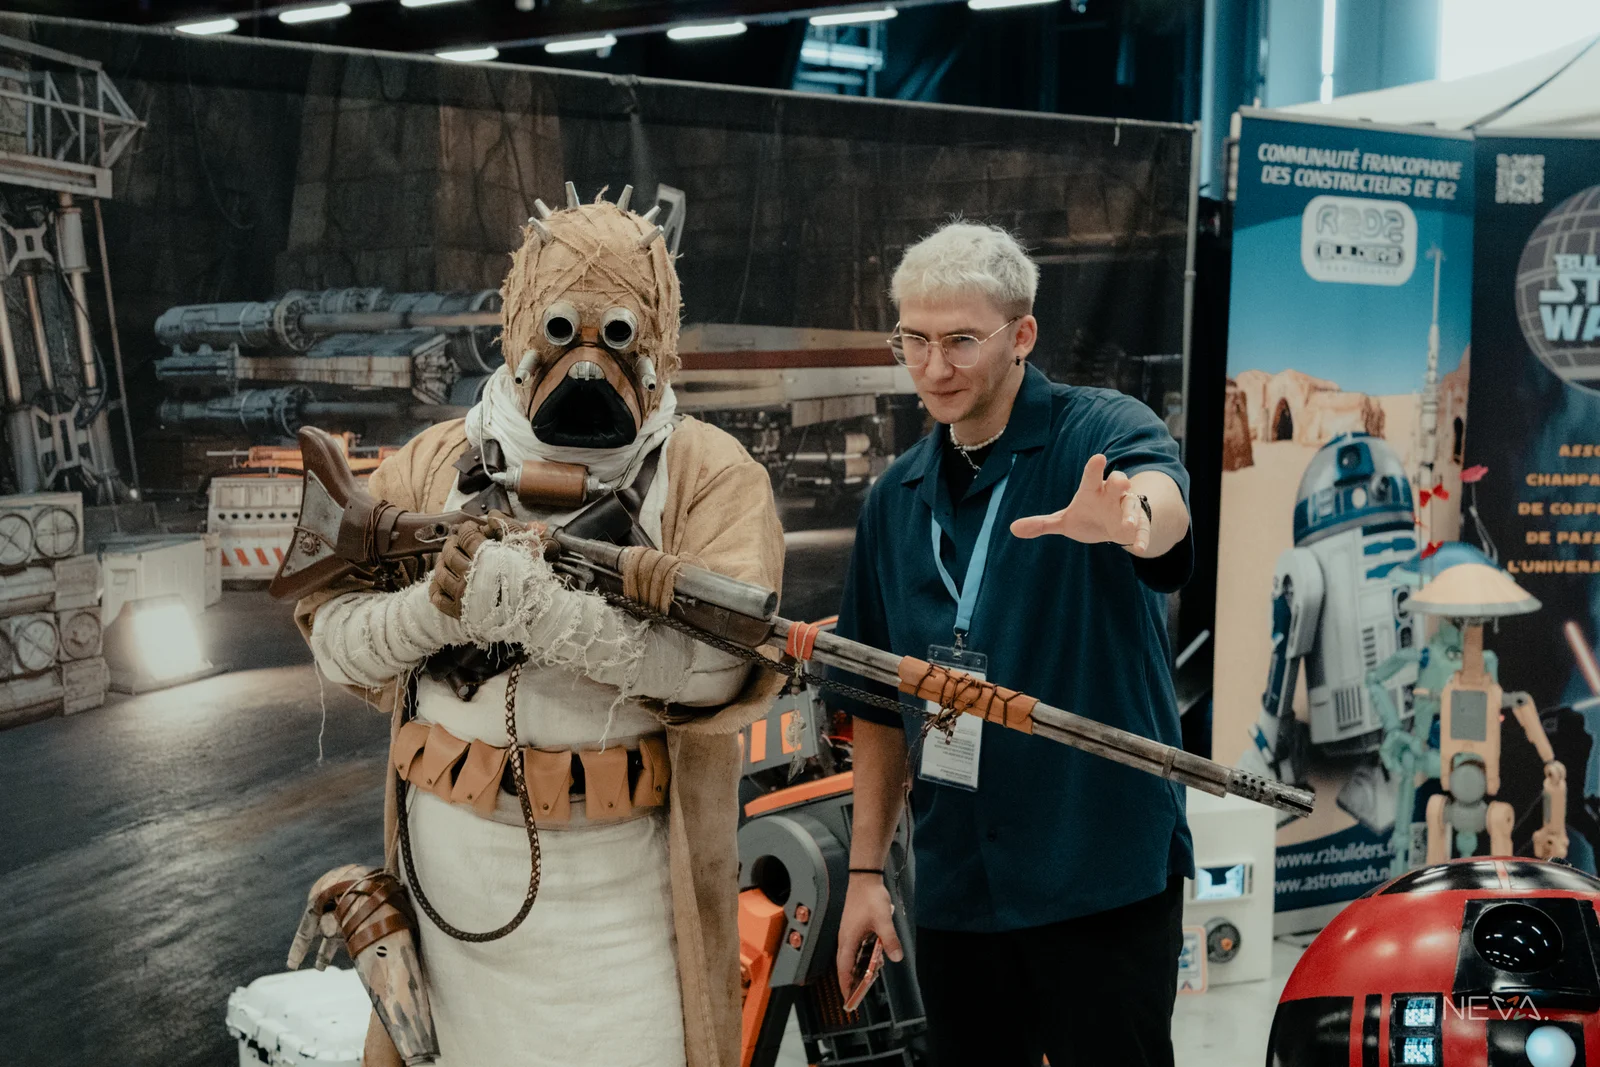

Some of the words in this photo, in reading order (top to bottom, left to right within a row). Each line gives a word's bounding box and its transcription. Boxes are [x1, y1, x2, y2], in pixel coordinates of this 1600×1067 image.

[1257, 143, 1360, 171] COMMUNAUTÉ
[1361, 152, 1463, 180] FRANCOPHONE
[1260, 165, 1292, 185] DES
[1293, 168, 1412, 196] CONSTRUCTEURS
[1414, 178, 1435, 198] DE
[1436, 181, 1457, 200] R2
[1525, 473, 1600, 486] CHAMPA
[1517, 502, 1544, 516] DE
[1525, 531, 1550, 545] DE
